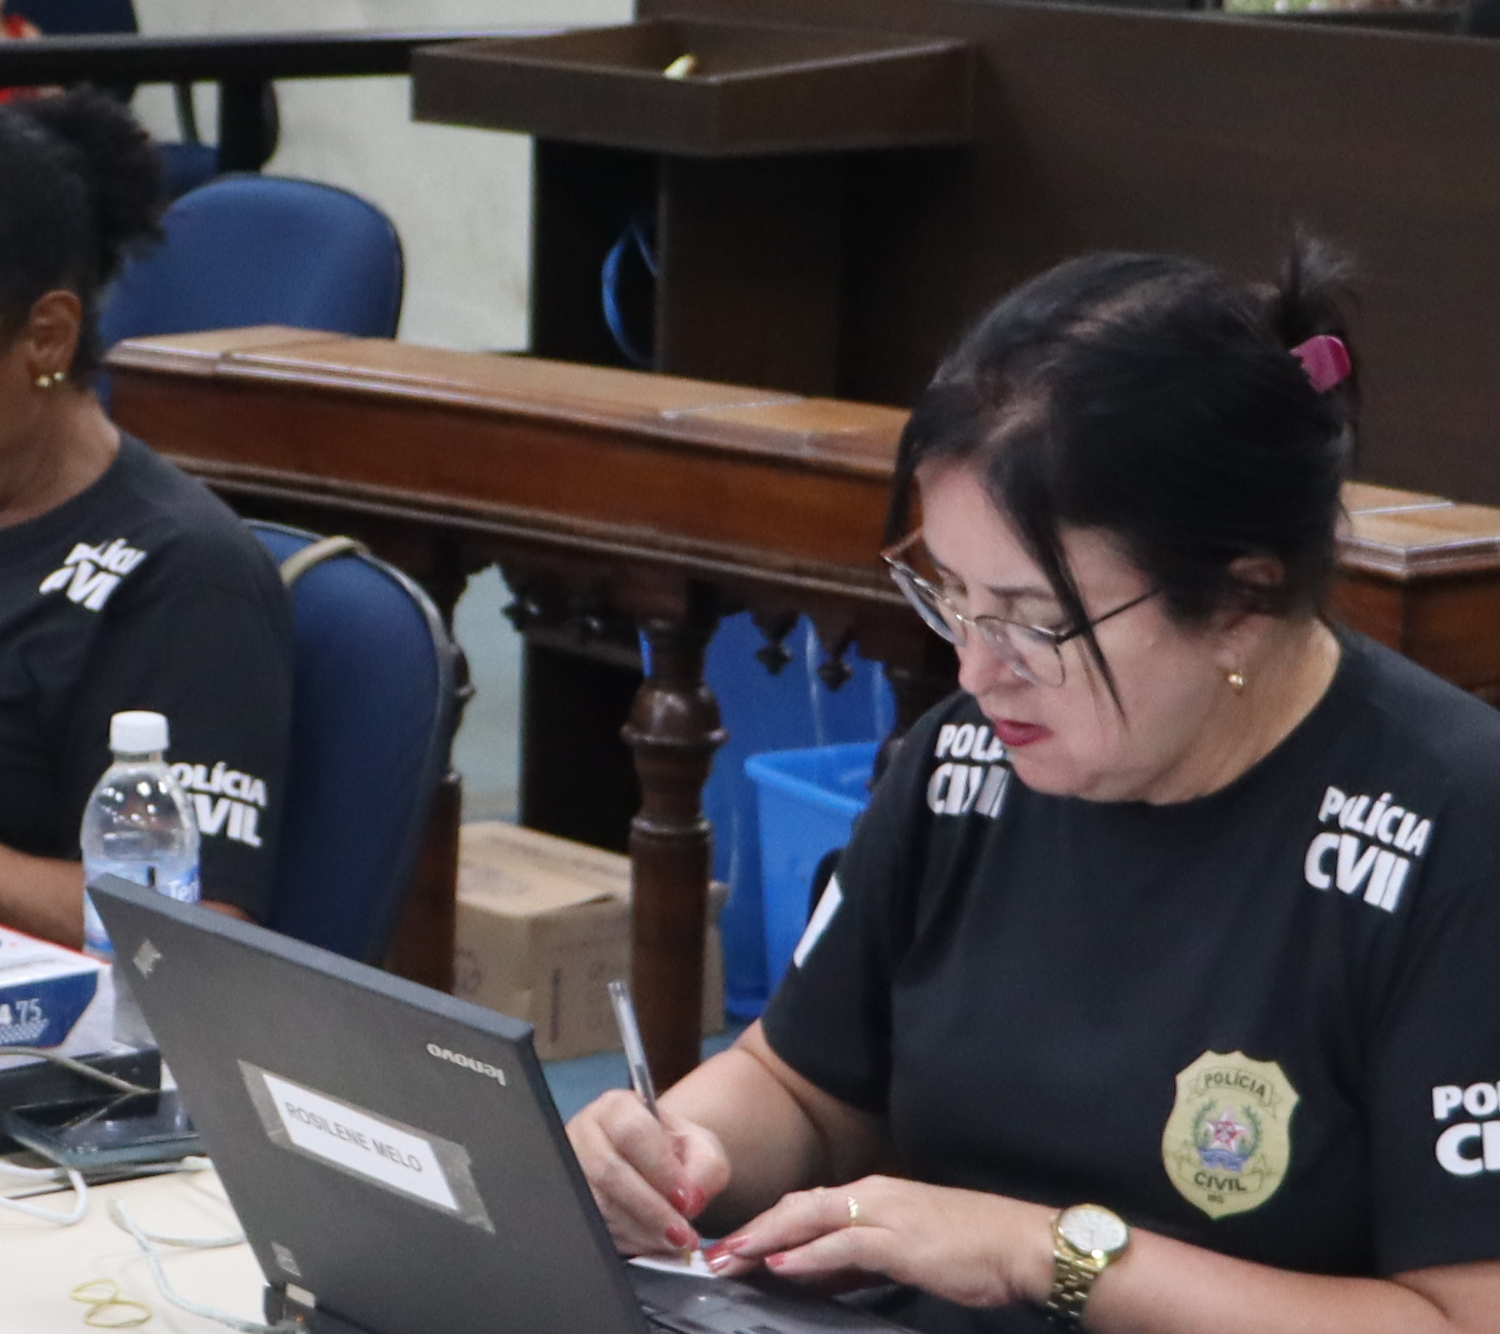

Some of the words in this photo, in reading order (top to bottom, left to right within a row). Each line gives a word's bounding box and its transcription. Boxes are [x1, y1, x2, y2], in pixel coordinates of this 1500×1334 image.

[168, 761, 268, 808] OLÍCIA
[425, 1042, 507, 1087] lenovo
[1204, 1072, 1266, 1098] POLÍCIA
[284, 1100, 372, 1152] ROSILENE
[371, 1137, 423, 1174] MELO
[1194, 1172, 1247, 1192] CIVIL
